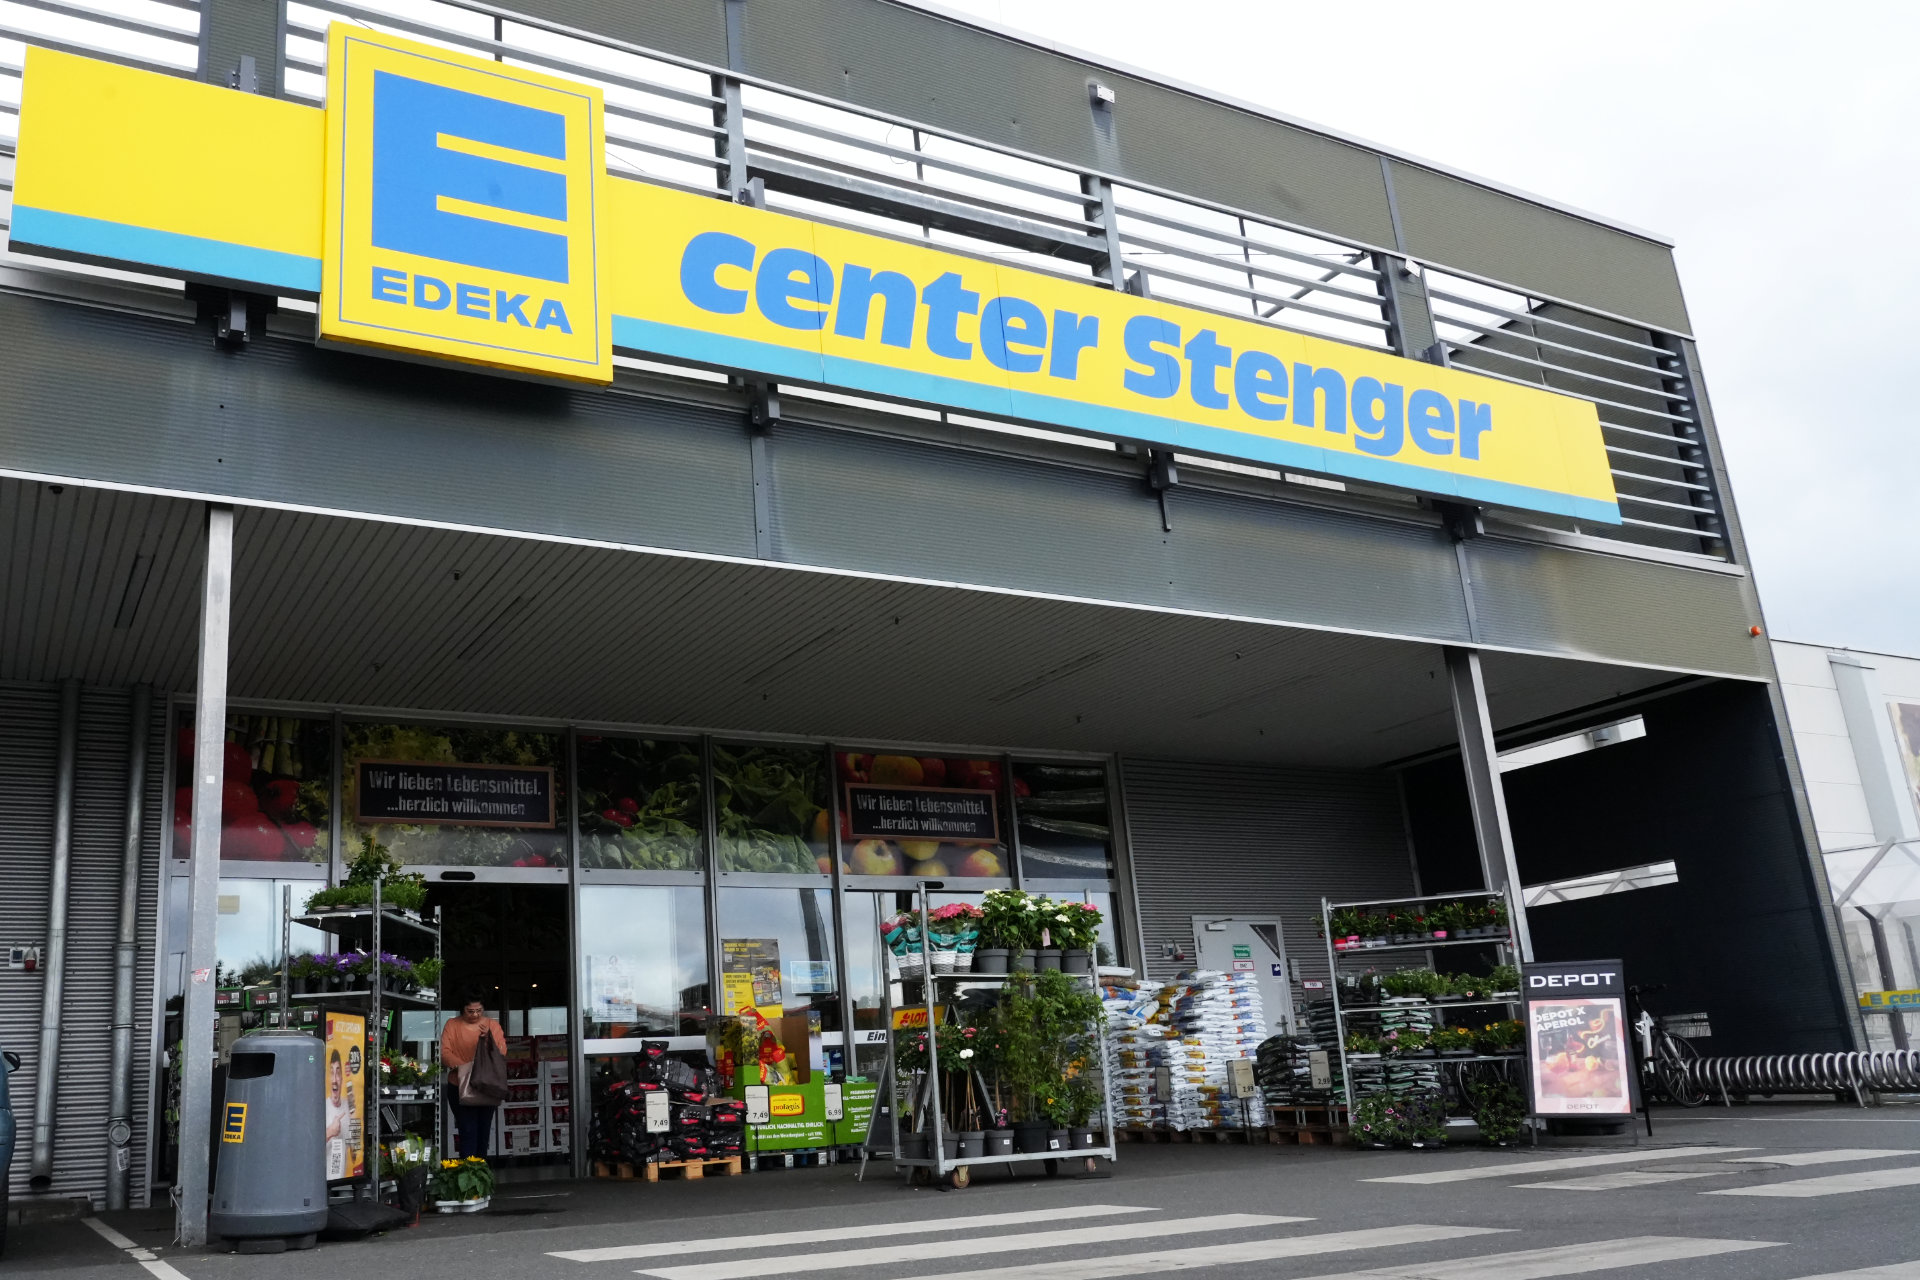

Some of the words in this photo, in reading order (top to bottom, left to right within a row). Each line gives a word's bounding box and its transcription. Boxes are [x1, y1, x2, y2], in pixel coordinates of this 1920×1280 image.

[371, 70, 569, 285] E
[371, 266, 573, 335] EDEKA
[680, 232, 1098, 381] center
[1124, 315, 1492, 460] Stenger
[369, 770, 395, 789] Wir
[399, 772, 443, 792] lieben
[447, 774, 542, 796] Lebensmittel.
[387, 795, 449, 814] ...herzlich
[452, 798, 526, 816] willkommen
[856, 794, 877, 811] Wir
[879, 795, 912, 813] lieben
[915, 796, 988, 816] Lebensmittel.
[920, 817, 977, 833] willkommen
[1529, 973, 1616, 988] DEPOT
[910, 1011, 936, 1025] LOTT
[1535, 1008, 1574, 1024] DEPOT
[1577, 1006, 1586, 1016] X
[1536, 1016, 1585, 1032] APEROL
[653, 1119, 669, 1127] 7,49
[753, 1111, 768, 1119] 7,49
